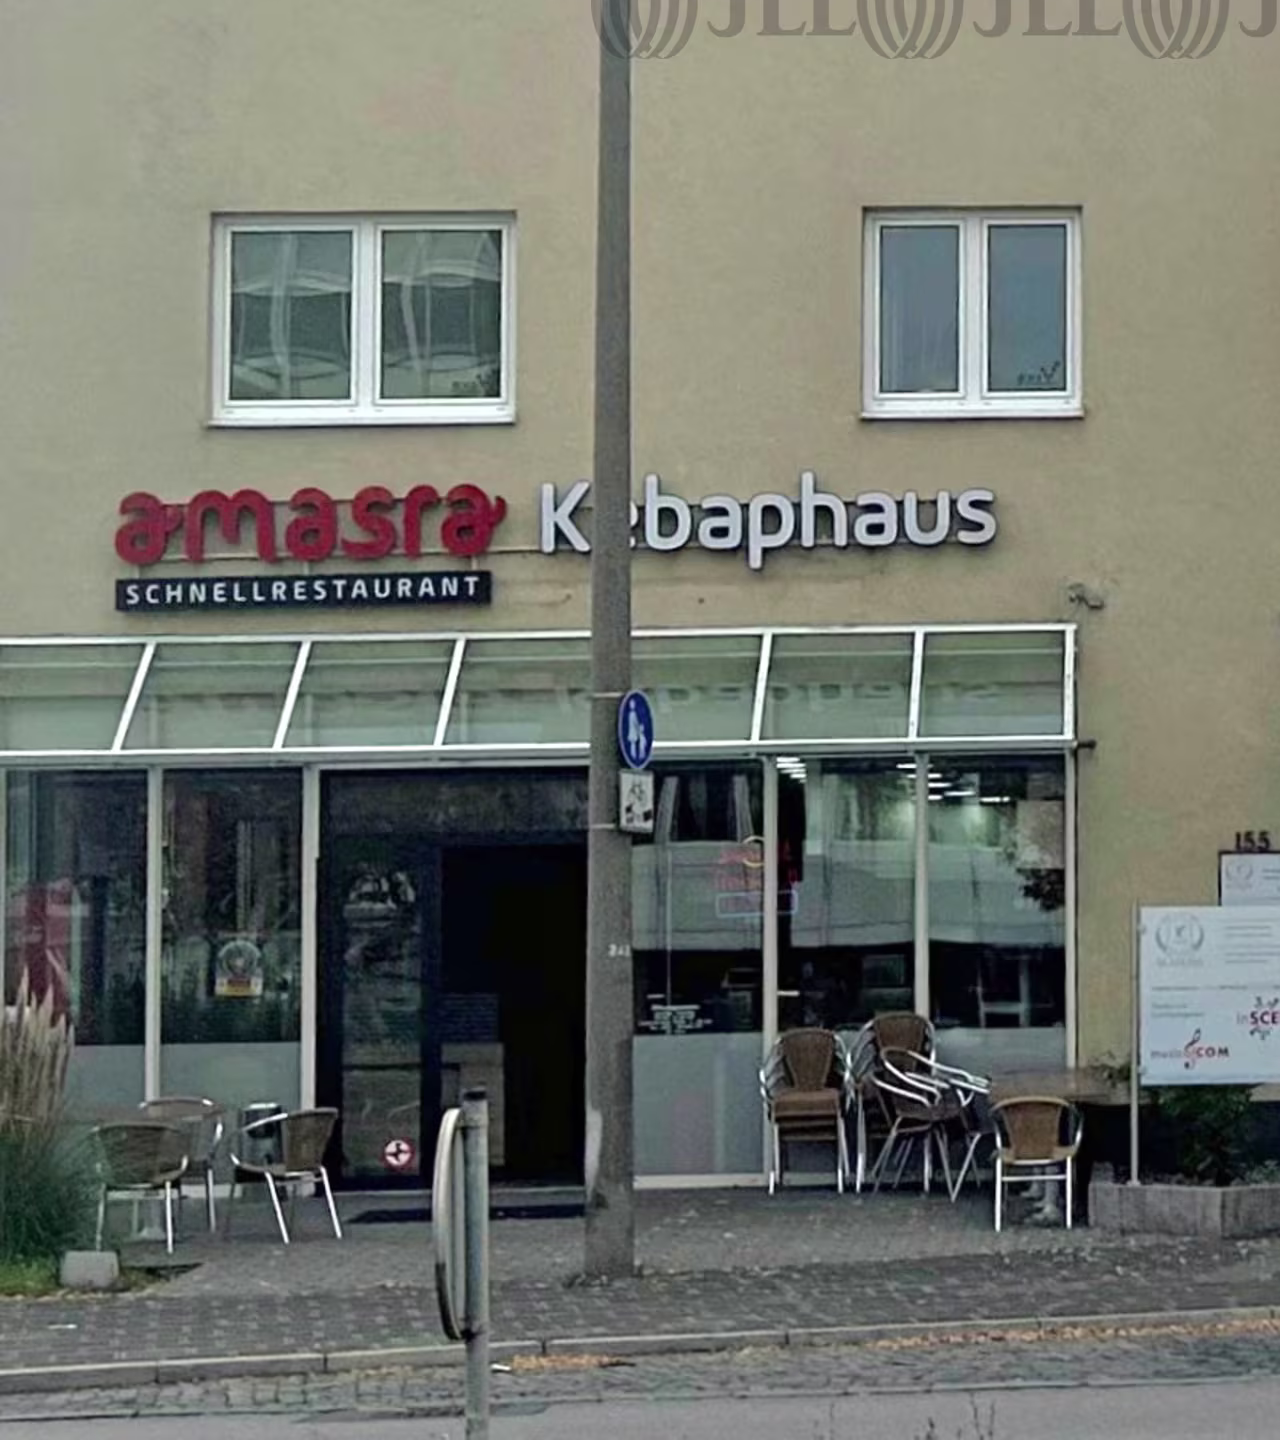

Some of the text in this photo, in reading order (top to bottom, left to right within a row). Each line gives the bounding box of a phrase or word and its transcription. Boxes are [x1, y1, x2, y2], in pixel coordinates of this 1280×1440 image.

[115, 483, 507, 565] amasra
[540, 470, 997, 570] Kbaphaus
[126, 575, 480, 605] SCHNELLRESTAURANT
[1234, 830, 1272, 851] 155
